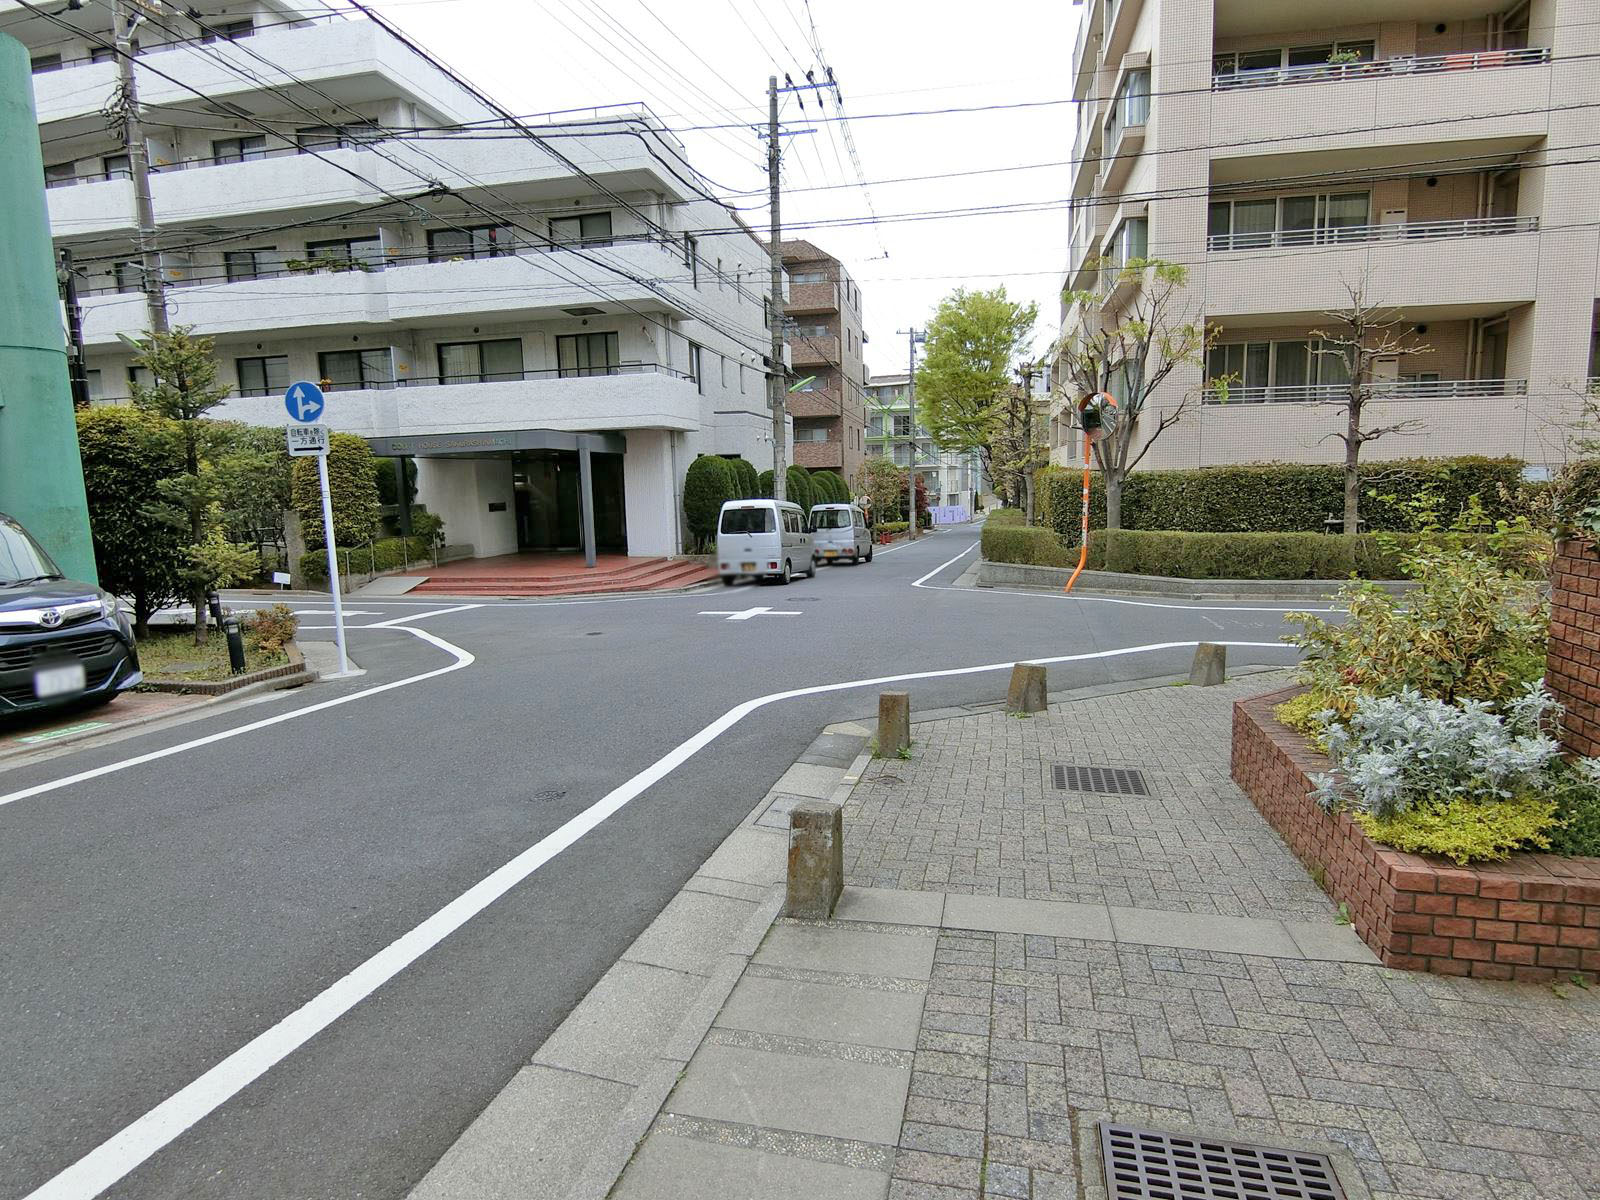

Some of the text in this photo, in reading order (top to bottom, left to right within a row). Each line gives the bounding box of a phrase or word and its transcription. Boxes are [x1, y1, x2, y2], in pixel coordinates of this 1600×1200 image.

[290, 427, 325, 437] 自転車を除く
[291, 436, 325, 445] 一方通行
